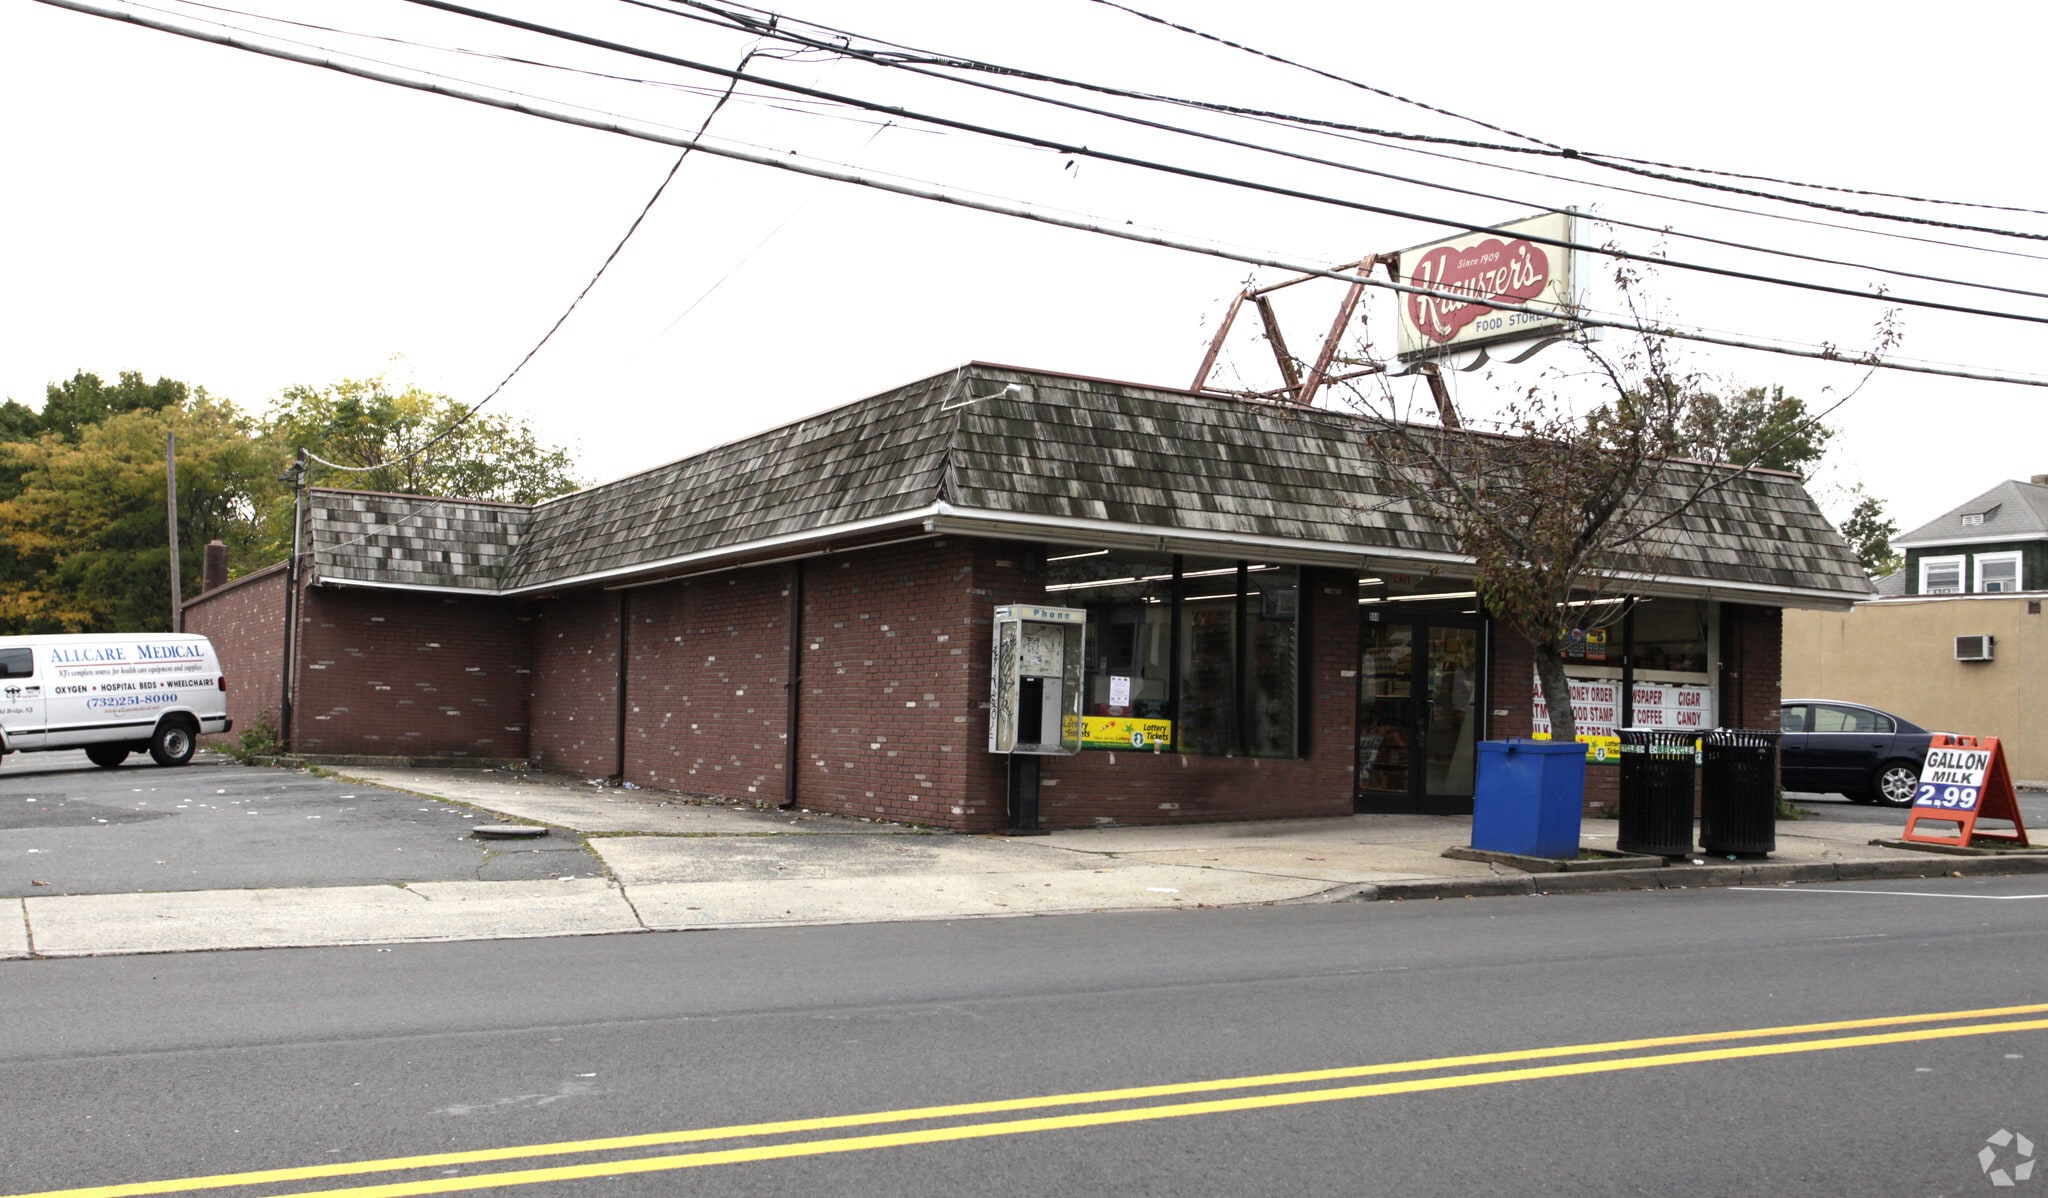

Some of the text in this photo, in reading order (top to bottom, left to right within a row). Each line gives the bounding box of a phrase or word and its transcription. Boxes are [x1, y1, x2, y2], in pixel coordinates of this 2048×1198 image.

[1457, 252, 1500, 269] Since 1909
[1476, 317, 1503, 332] FOOD
[1033, 609, 1071, 619] Phone
[55, 678, 214, 695] OXYGEN HOSPITAL BEDS WHEELCHAIRS
[1591, 686, 1614, 702] ORDER
[86, 693, 178, 709] (732)251-8000
[1632, 689, 1663, 705] WSPAPER
[1678, 691, 1701, 707] CIGAR
[1573, 705, 1588, 721] OOD
[1590, 706, 1614, 722] STAMP
[1636, 709, 1663, 725] COFFEE
[1676, 710, 1702, 726] CANDY
[1143, 723, 1168, 734] Lottery
[1146, 732, 1169, 740] Tickets
[1928, 751, 1988, 770] GALLON
[1932, 771, 1973, 784] MILK
[1916, 785, 1977, 809] 2.99
